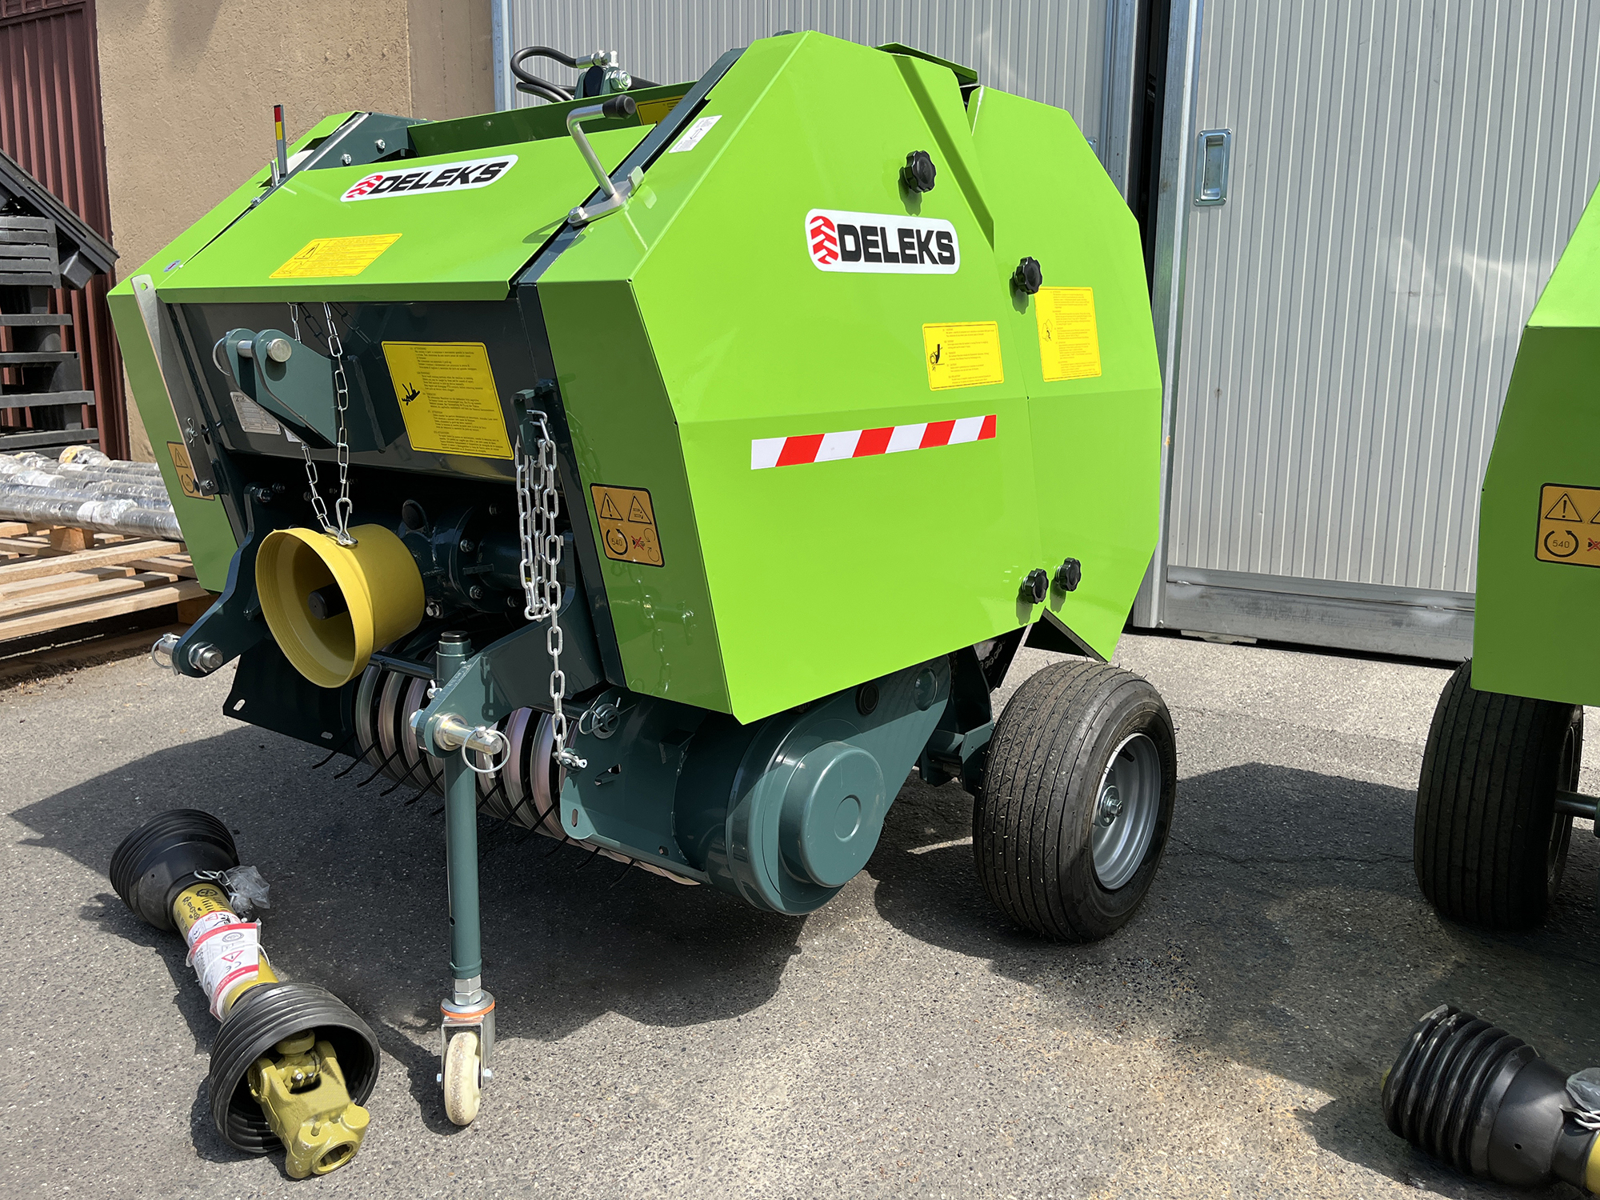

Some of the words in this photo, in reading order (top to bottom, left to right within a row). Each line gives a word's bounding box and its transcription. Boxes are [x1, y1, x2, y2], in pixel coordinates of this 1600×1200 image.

[367, 161, 509, 195] DELEKS
[837, 223, 956, 265] DELEKS
[611, 537, 623, 547] 540
[1552, 540, 1570, 549] 540
